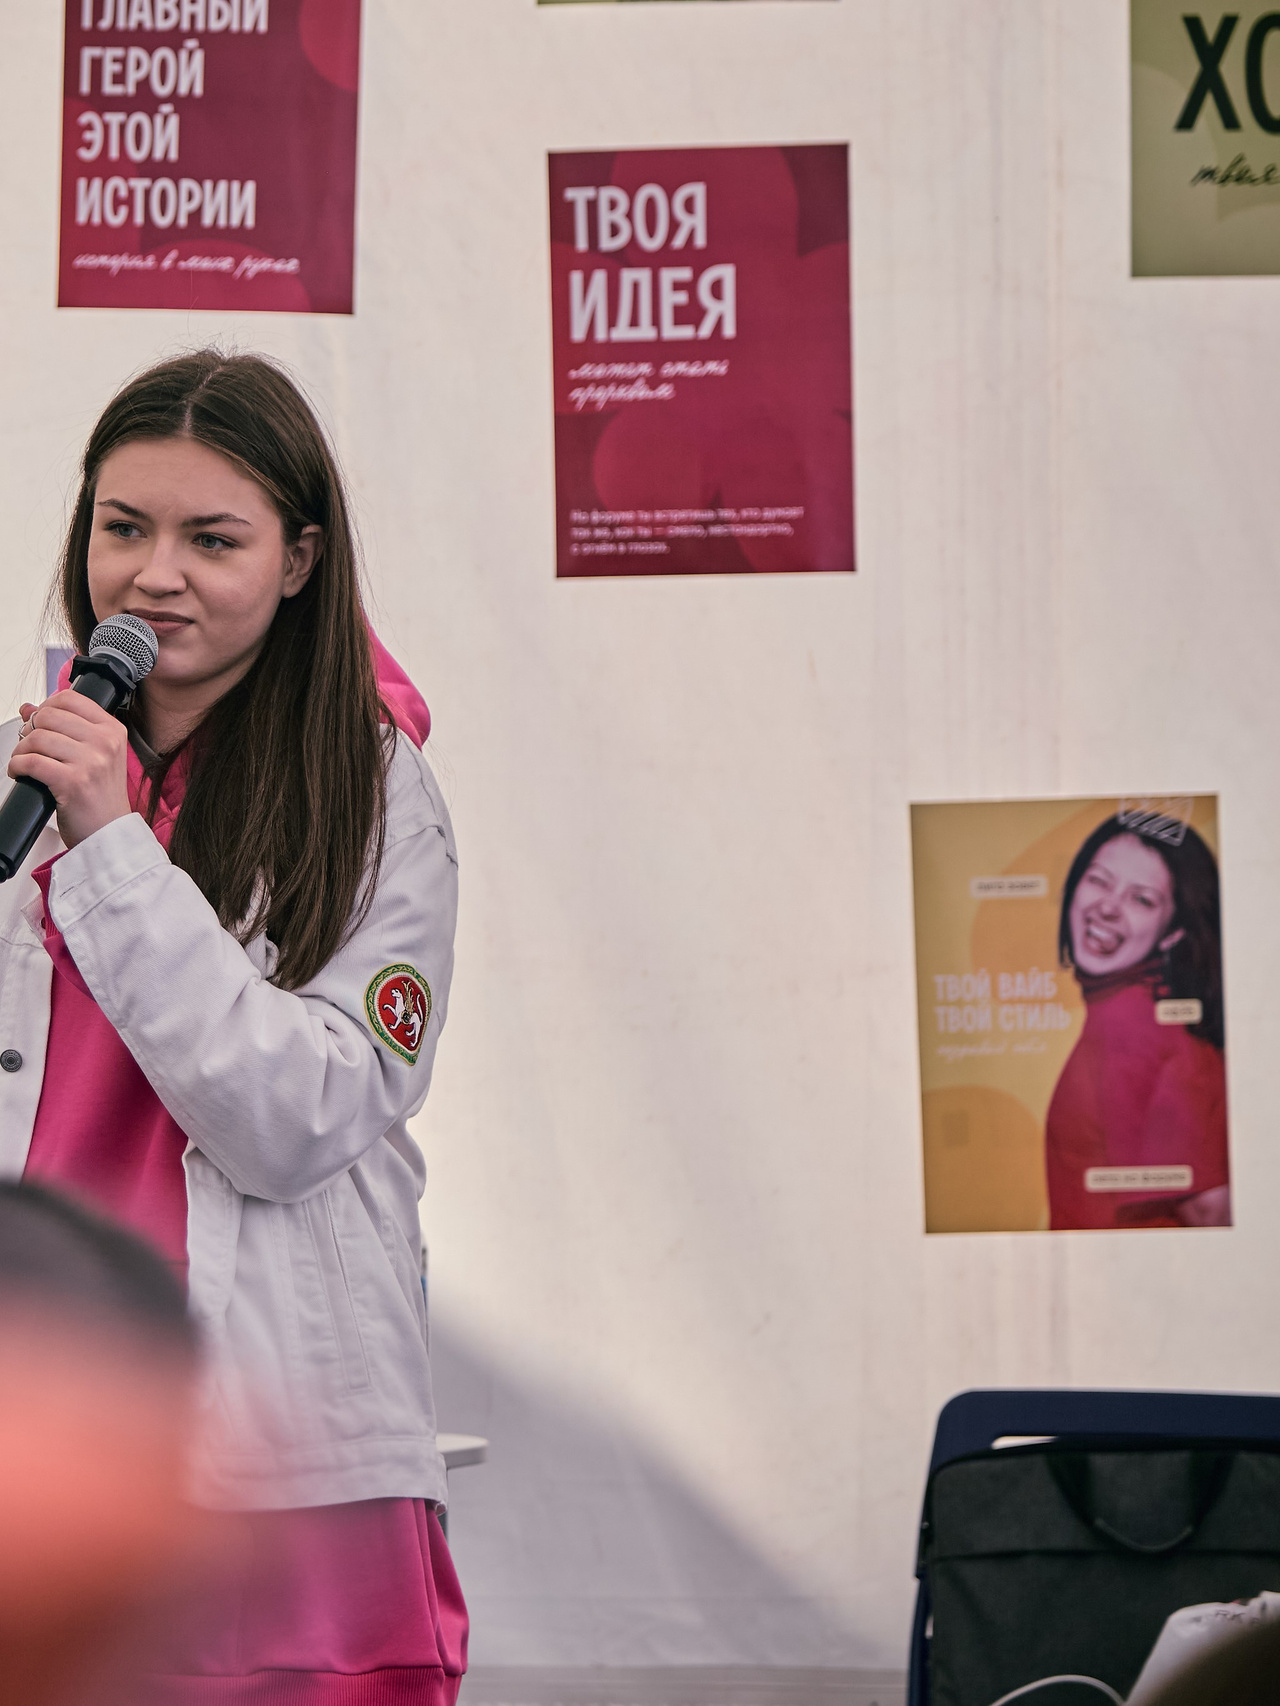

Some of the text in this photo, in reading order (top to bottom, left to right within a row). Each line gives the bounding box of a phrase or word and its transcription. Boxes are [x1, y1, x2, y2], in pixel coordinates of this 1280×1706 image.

[78, 38, 205, 98] ГЕРОЙ
[76, 103, 180, 162] ЭТОЙ
[75, 175, 257, 230] ИСТОРИИ
[563, 181, 708, 253] ТВОЯ
[568, 263, 737, 343] ИДЕЯ
[933, 966, 1058, 1001] ТВОЙ ВАЙБ
[934, 1000, 1072, 1034] ТВОЙ СТИЛЬ
